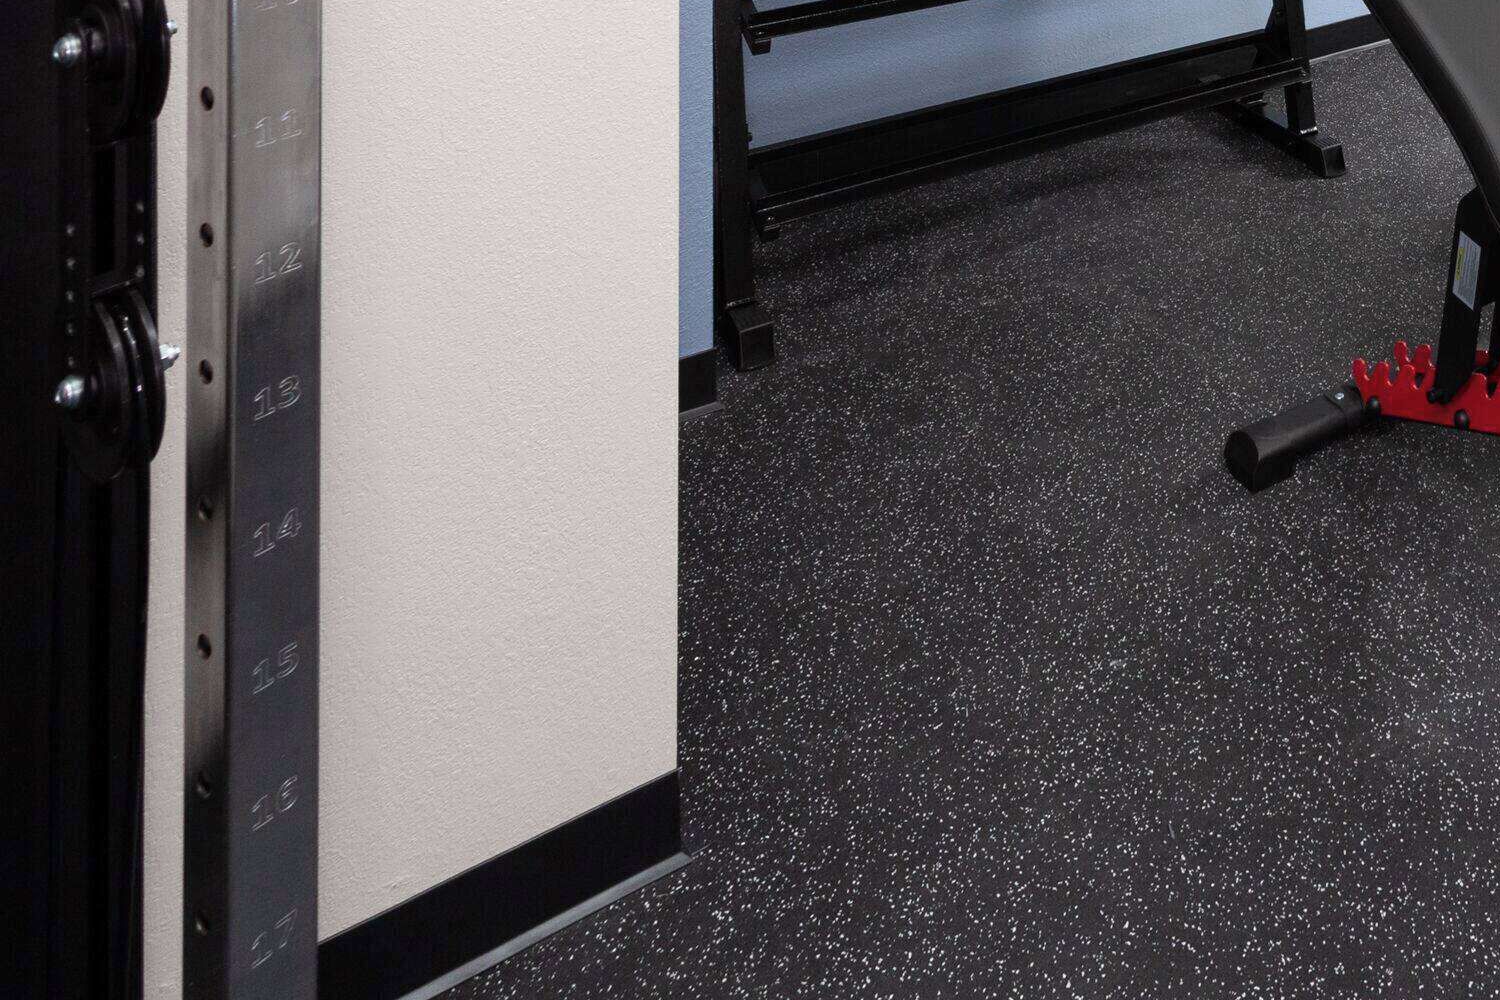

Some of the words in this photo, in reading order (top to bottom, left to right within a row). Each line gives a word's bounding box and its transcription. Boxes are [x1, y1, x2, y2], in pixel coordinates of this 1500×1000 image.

[255, 108, 303, 148] 11
[255, 241, 303, 285] 12
[254, 374, 301, 422] 13
[253, 506, 302, 558] 14
[252, 641, 300, 695] 15
[251, 774, 299, 832] 16
[251, 907, 298, 969] 17
